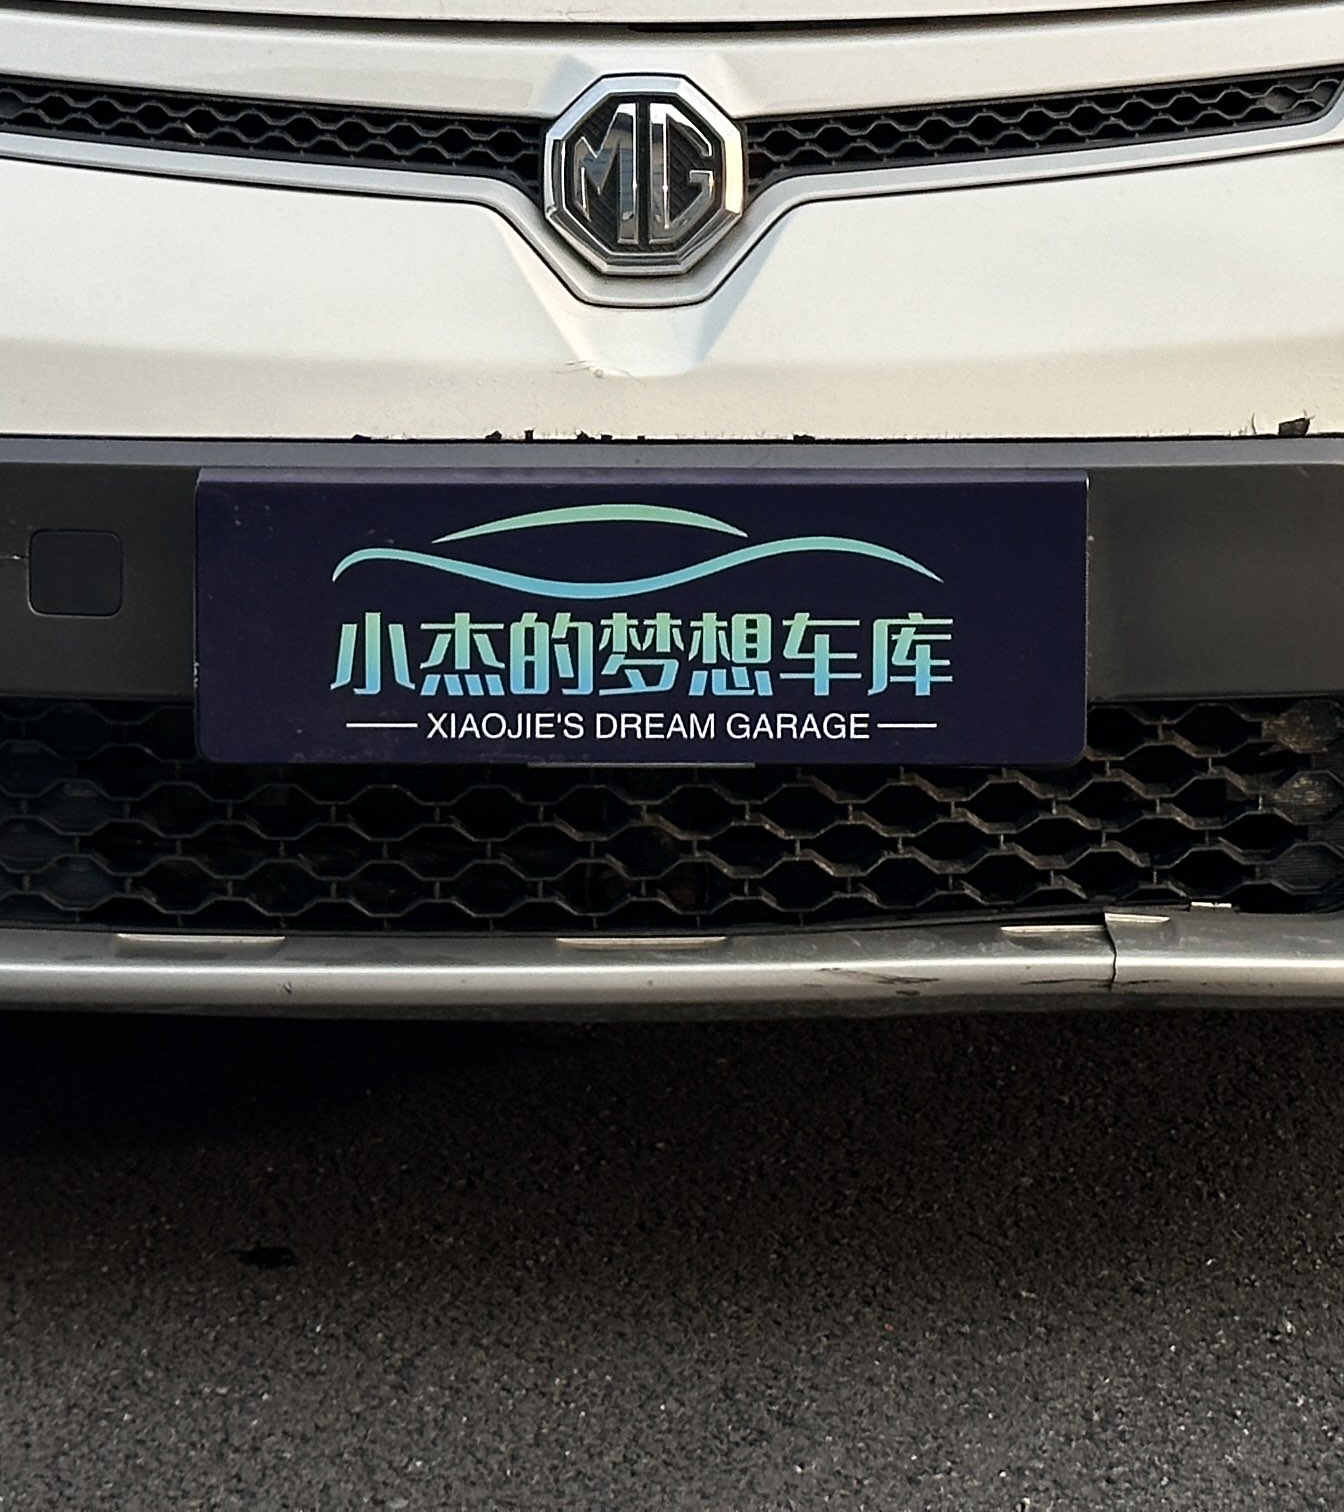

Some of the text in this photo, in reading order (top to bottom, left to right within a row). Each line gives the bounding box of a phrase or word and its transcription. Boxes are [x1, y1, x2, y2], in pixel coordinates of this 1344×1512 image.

[574, 102, 714, 245] MG
[330, 612, 954, 696] 小杰的梦想车库
[426, 712, 871, 739] XIAOJIE'S DREAM GARAGE
